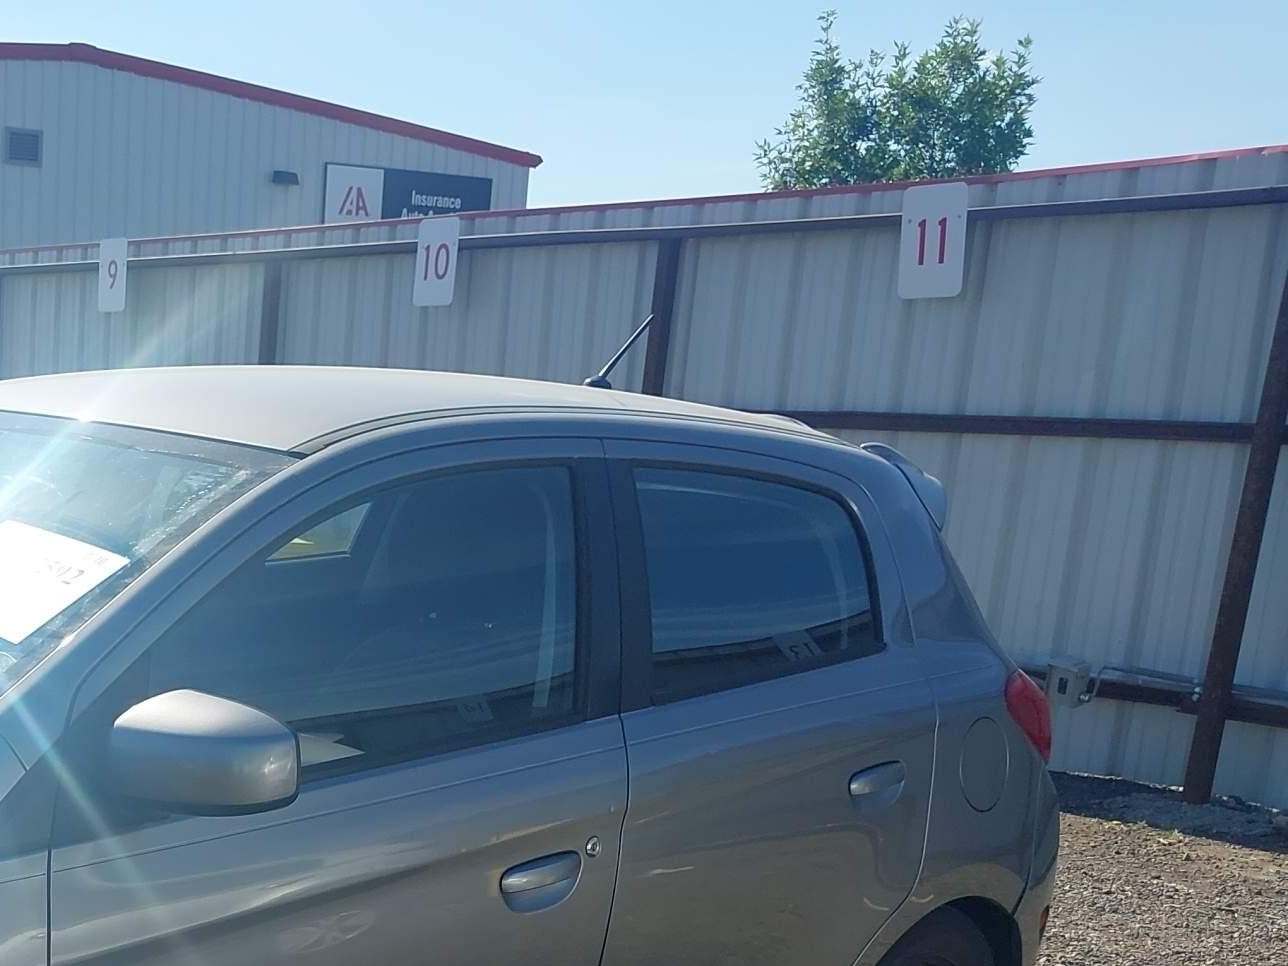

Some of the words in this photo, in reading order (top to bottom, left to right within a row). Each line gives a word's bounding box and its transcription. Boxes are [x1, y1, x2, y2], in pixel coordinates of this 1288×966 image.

[411, 190, 461, 208] Insurance
[917, 216, 948, 266] 11
[107, 259, 118, 289] 9
[423, 243, 450, 281] 10
